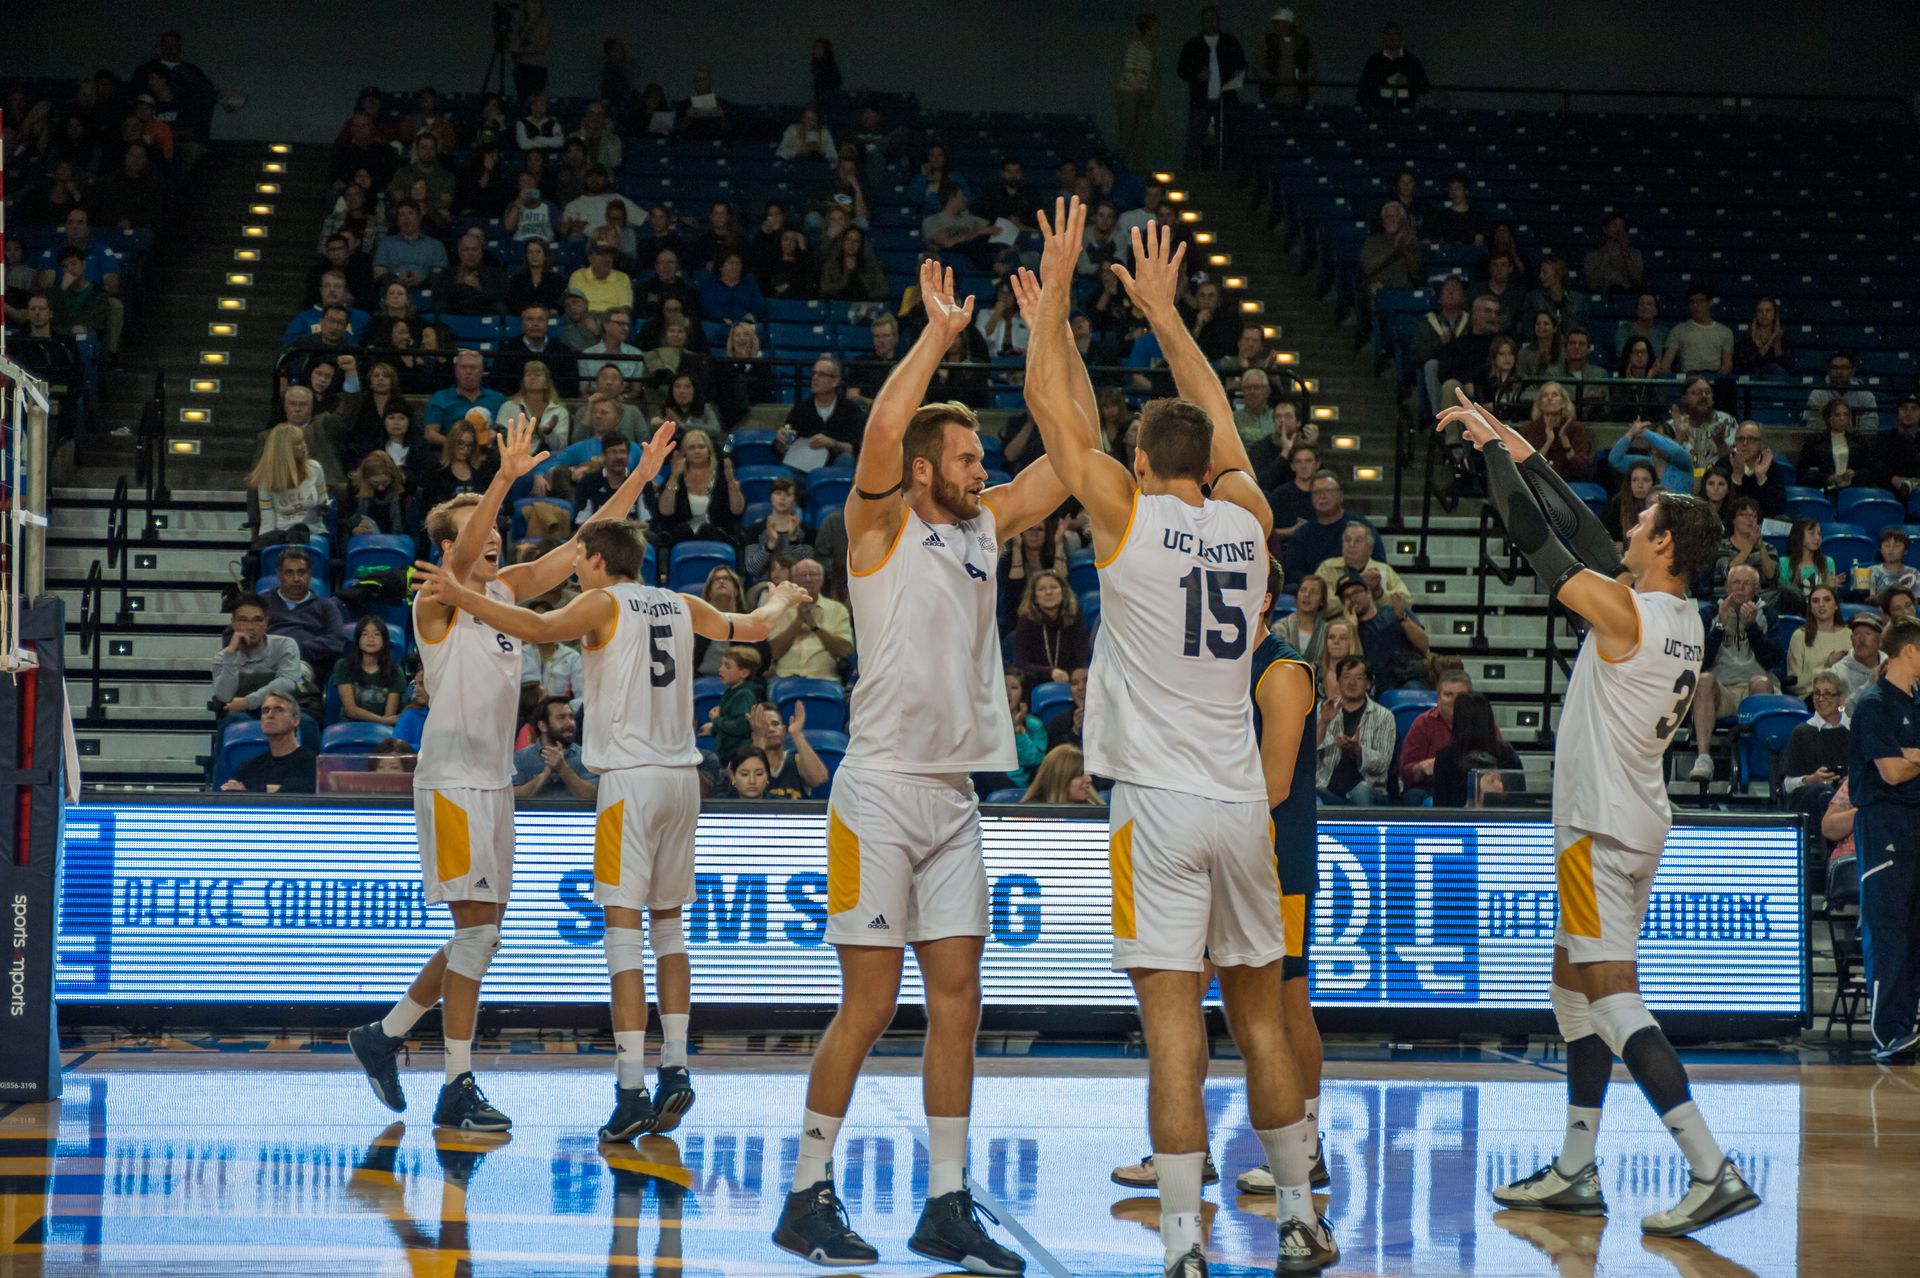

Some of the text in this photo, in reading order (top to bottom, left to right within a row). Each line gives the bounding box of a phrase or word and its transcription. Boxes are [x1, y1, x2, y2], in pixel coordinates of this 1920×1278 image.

[1163, 528, 1193, 553] UC
[965, 562, 987, 581] 4
[1180, 566, 1247, 660] 15
[497, 633, 513, 652] 6
[650, 624, 676, 687] 5
[1664, 637, 1681, 658] UC
[1655, 669, 1697, 740] 3
[12, 895, 28, 948] sports
[557, 869, 1041, 949] SMSG
[1638, 893, 1772, 941] LUTIONS
